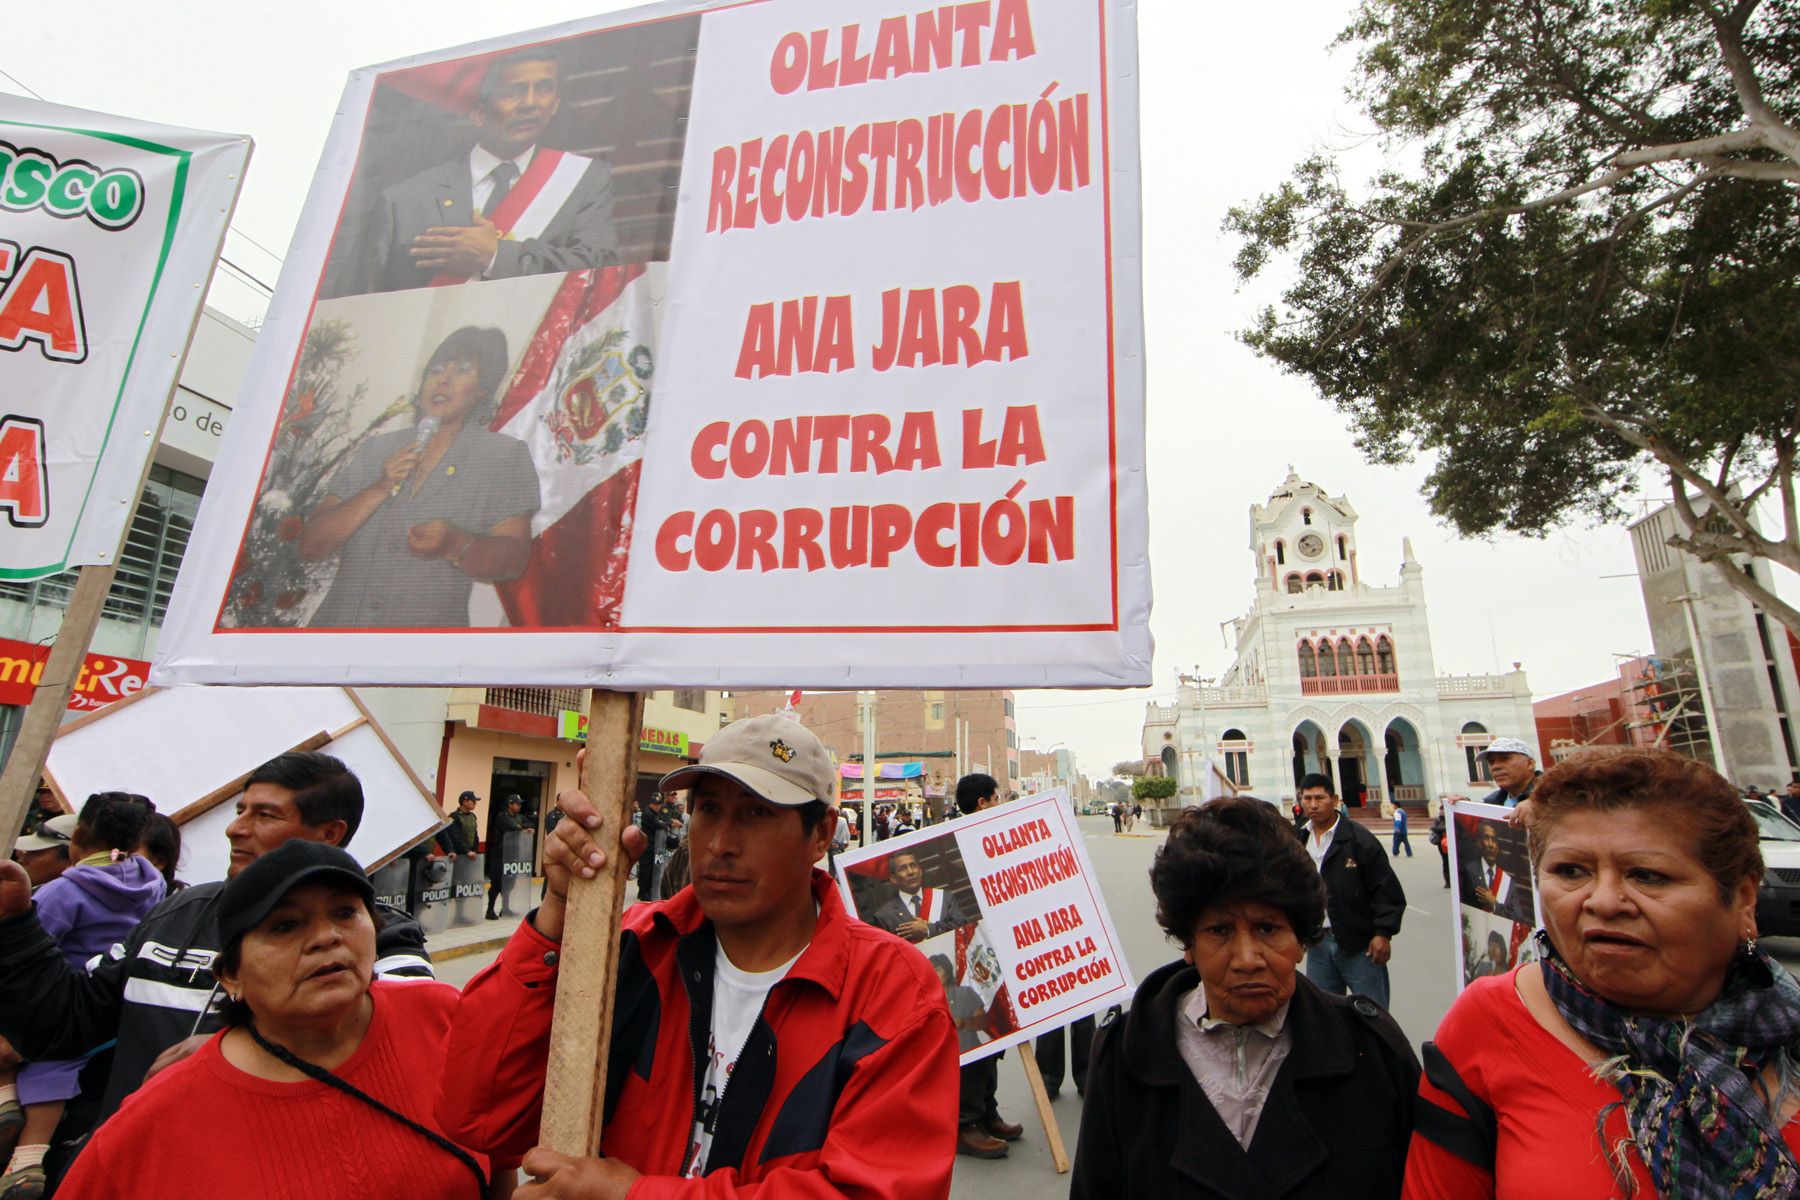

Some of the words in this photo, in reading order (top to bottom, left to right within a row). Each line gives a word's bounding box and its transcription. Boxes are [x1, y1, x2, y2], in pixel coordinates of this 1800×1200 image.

[769, 0, 1036, 95] OLLANTA
[706, 81, 1090, 235] RECONSTRUCCIÓN
[734, 294, 855, 380] ANA
[871, 280, 1029, 372] JARA
[196, 412, 223, 437] de
[691, 411, 941, 480] CONTRA
[962, 405, 1046, 469] LA
[655, 479, 1075, 573] CORRUPCIÓN
[982, 818, 1052, 859] OLLANTA
[980, 844, 1079, 907] RECONSTRUCCIÓN
[1012, 917, 1046, 950] ANA
[1044, 903, 1083, 938] JARA
[1015, 944, 1076, 981] CONTRA
[1075, 935, 1098, 956] LA
[1018, 956, 1112, 1009] CORRUPCIÓN
